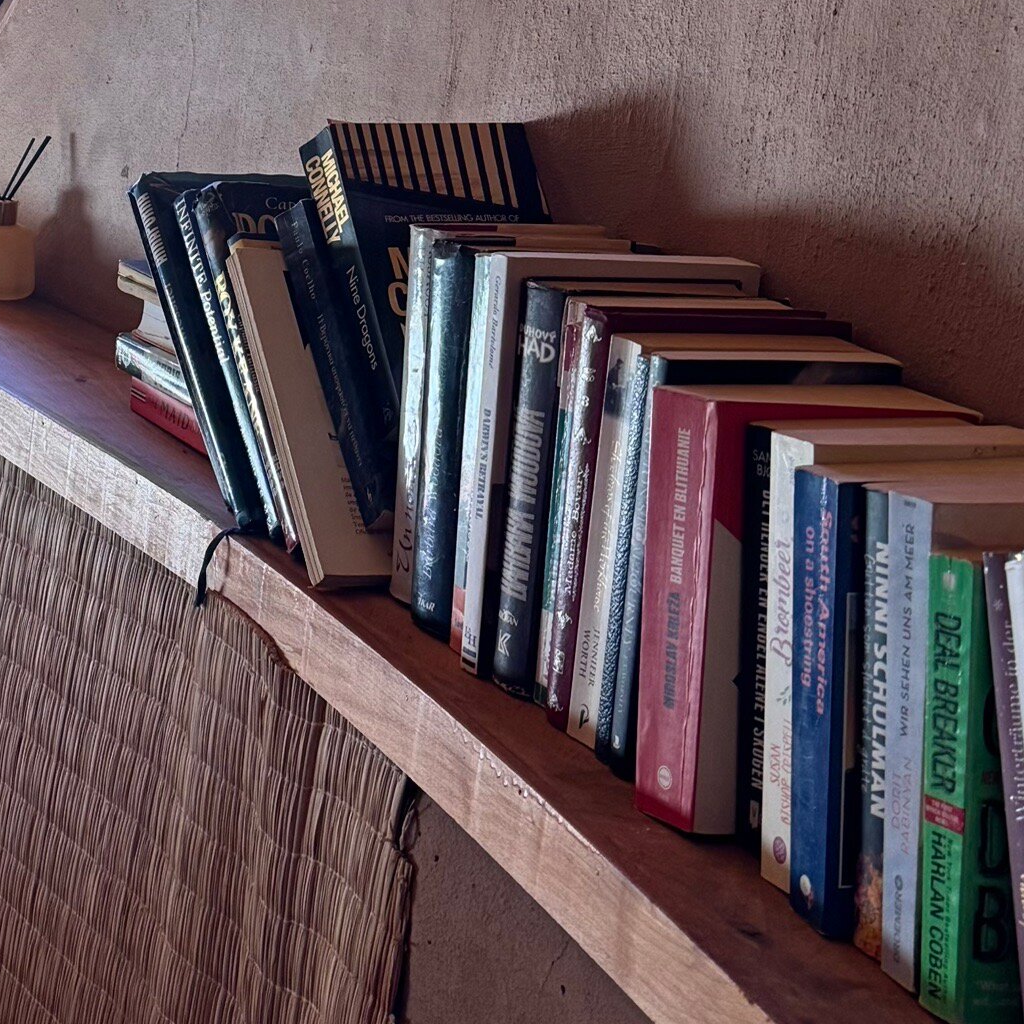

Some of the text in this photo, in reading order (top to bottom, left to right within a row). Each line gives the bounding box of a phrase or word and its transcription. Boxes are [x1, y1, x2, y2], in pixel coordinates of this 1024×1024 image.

[305, 155, 341, 245] CONNELLY
[321, 148, 349, 234] MICHAEL
[384, 214, 520, 223] FROM THE BESTSELLING AUTHOR OF
[175, 198, 230, 363] INFINITE Potential
[291, 220, 316, 300] Paulo Coelho
[491, 275, 502, 316] Gerardo
[346, 264, 377, 370] Nine Dragons
[517, 333, 556, 363] HAD
[475, 462, 488, 520] BETRAYAL
[564, 530, 578, 594] Madame
[571, 465, 584, 521] Bovary
[670, 428, 691, 585] BANQUET EN BLITHUANIE
[770, 536, 793, 667] Brombeer
[800, 526, 816, 688] on a shoestring
[815, 509, 833, 716] South America
[899, 524, 916, 737] WIR SEHEN UNS AM MEER
[933, 611, 962, 672] DEAL
[1001, 620, 1015, 653] der
[578, 629, 591, 679] WORTH
[588, 627, 601, 687] JENNIFER
[663, 641, 677, 711] MIROSLAV
[870, 541, 889, 819] NINNI SCHULMAN
[769, 743, 781, 787] SUSAN
[931, 677, 959, 795] BREAKER
[780, 777, 793, 826] BISHOP
[891, 772, 902, 830] DORIT
[901, 756, 913, 855] RABINYAN
[929, 829, 947, 921] HARLAN
[928, 925, 944, 1000] COBEN
